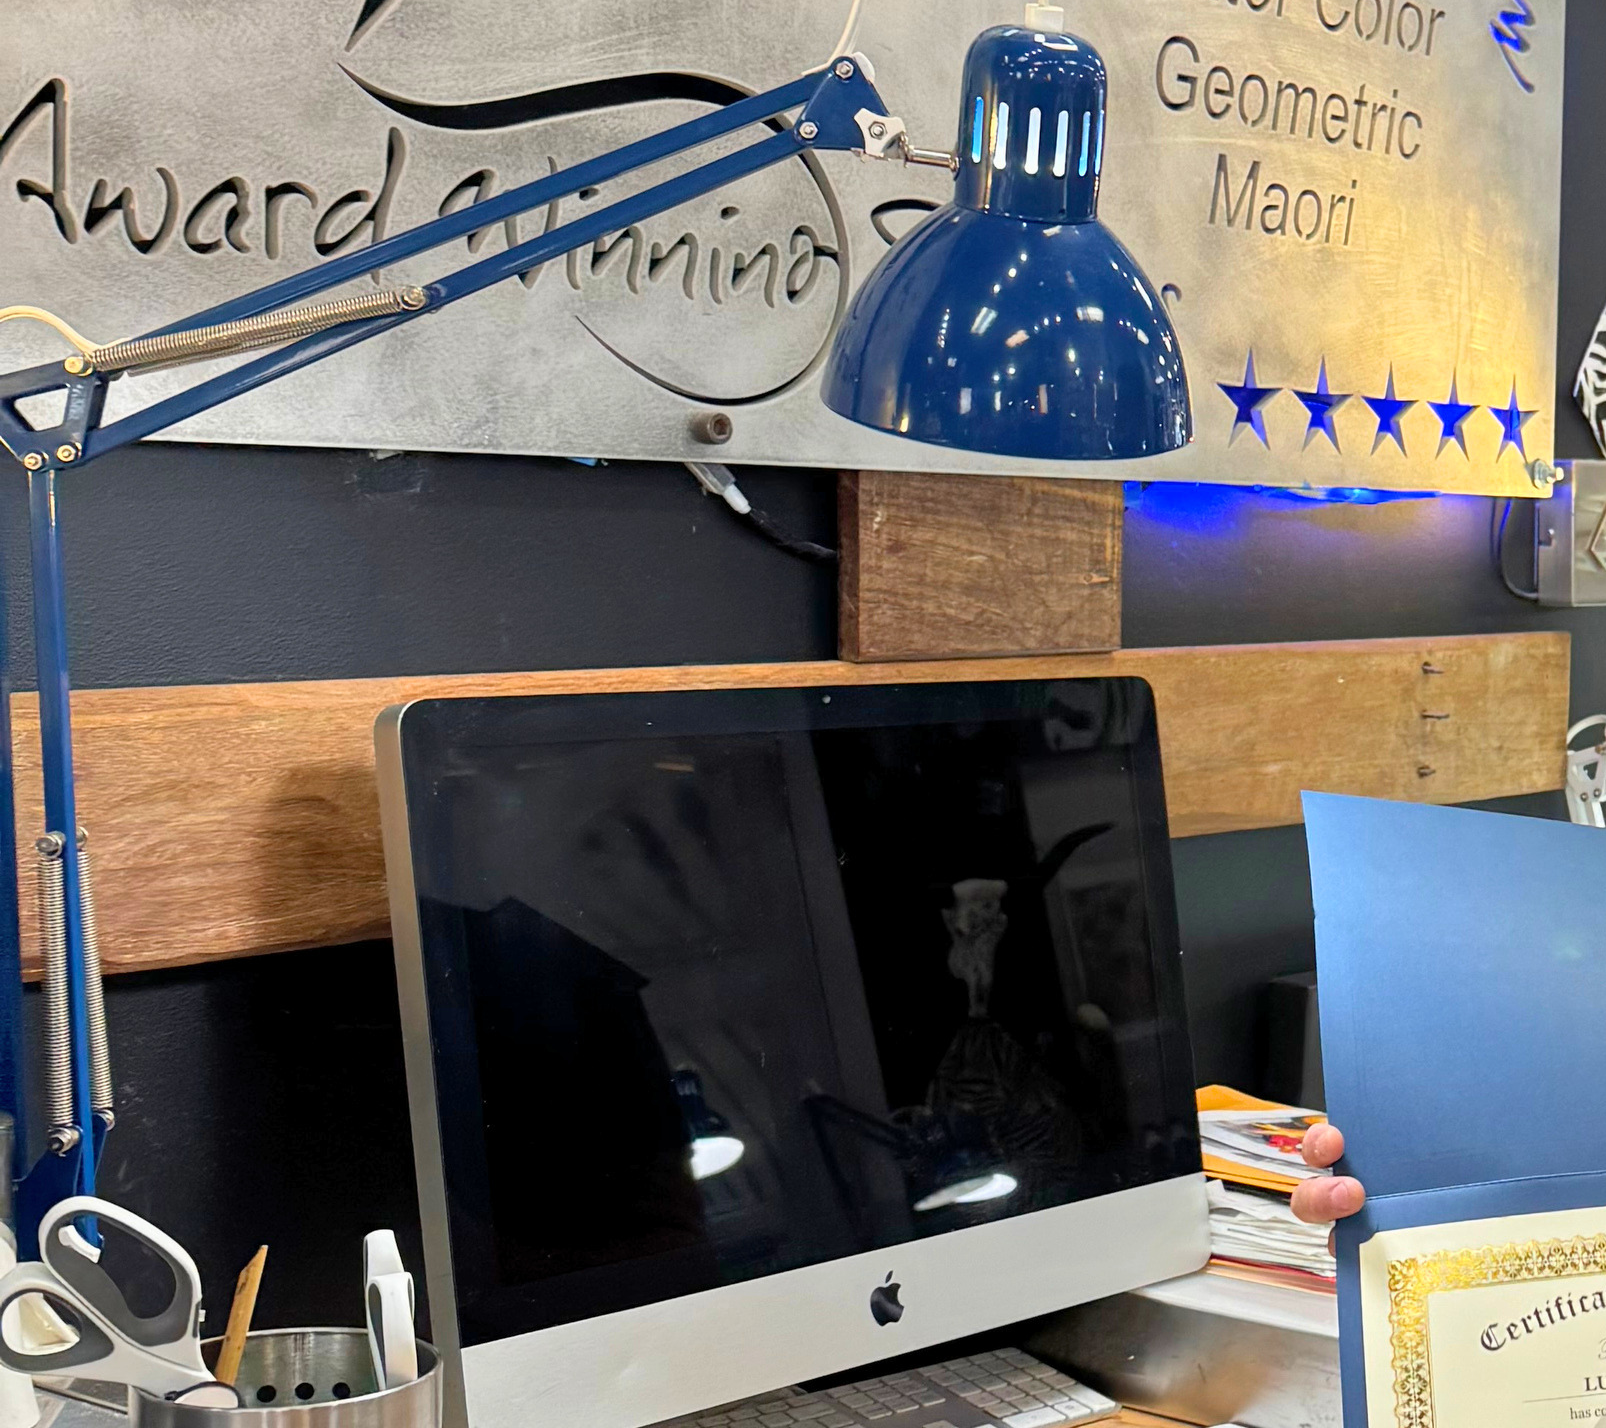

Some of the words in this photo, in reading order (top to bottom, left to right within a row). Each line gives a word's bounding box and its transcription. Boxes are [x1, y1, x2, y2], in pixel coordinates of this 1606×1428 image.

[1155, 34, 1424, 162] Geometric
[0, 77, 407, 284] Award
[1207, 152, 1359, 247] Maori
[1569, 1407, 1591, 1420] has
